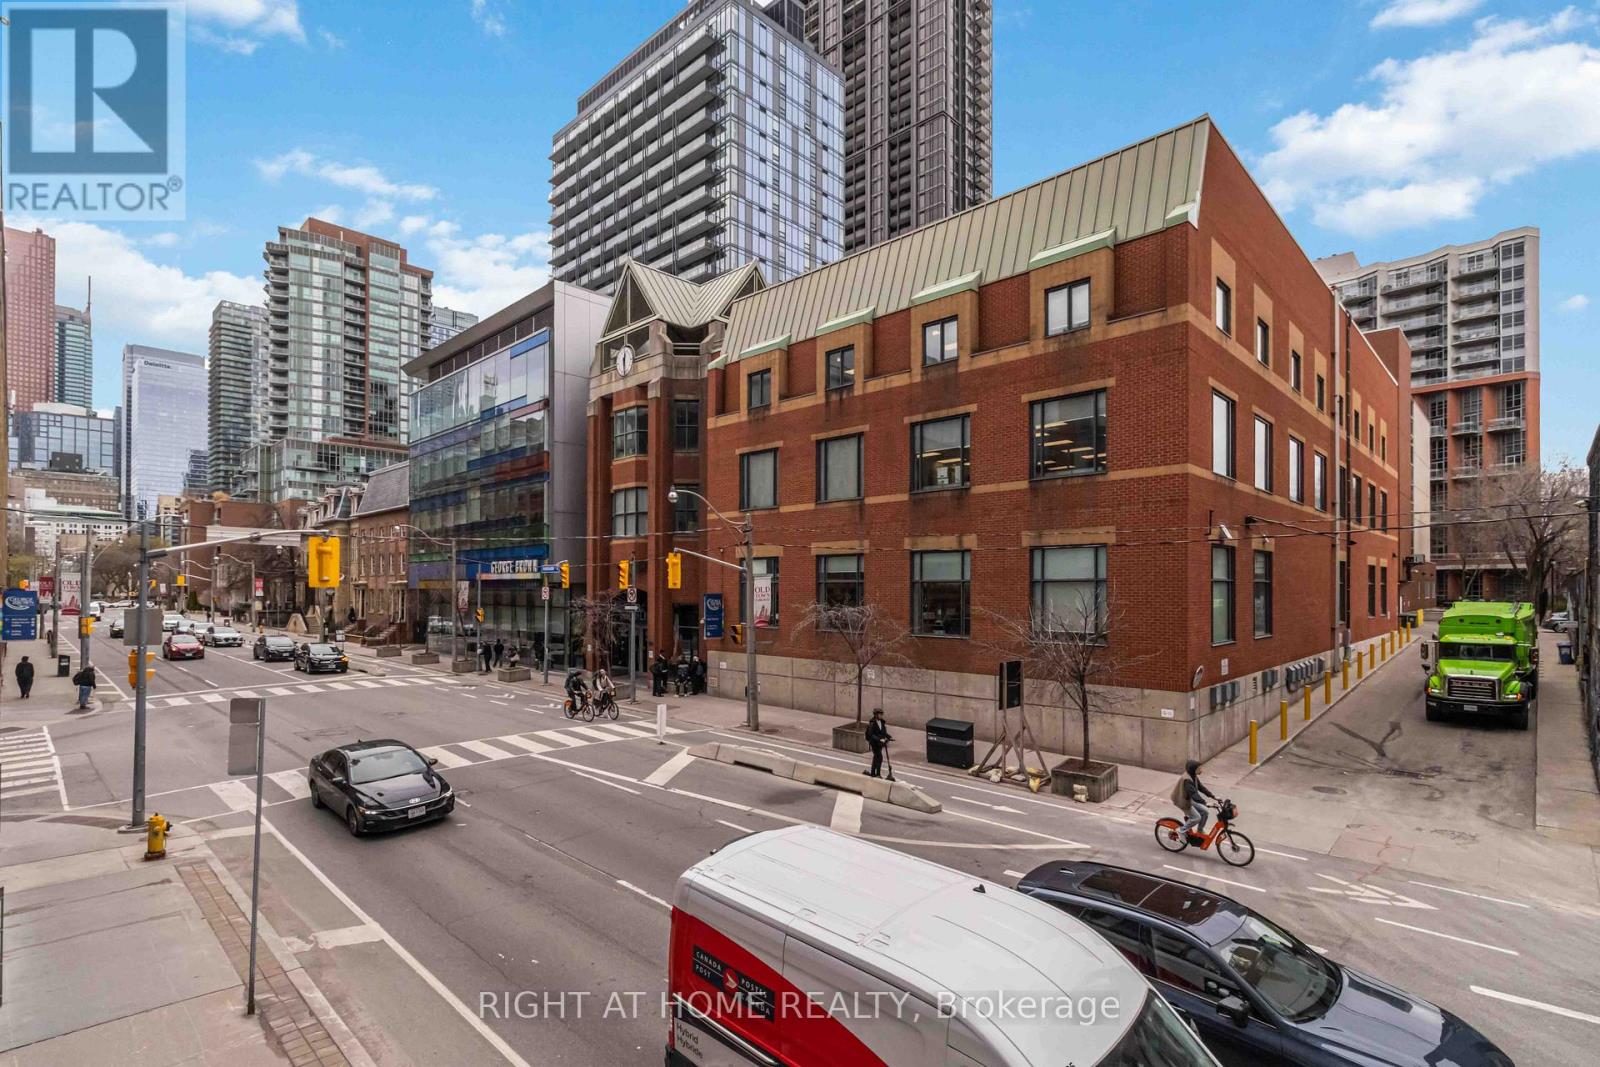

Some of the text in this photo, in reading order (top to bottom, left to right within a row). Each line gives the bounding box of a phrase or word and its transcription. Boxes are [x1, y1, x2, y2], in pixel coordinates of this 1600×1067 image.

[490, 560, 514, 574] GEORGE
[696, 951, 721, 971] CANADA
[676, 1022, 699, 1045] Hybrid
[676, 1035, 703, 1059] Hybride
